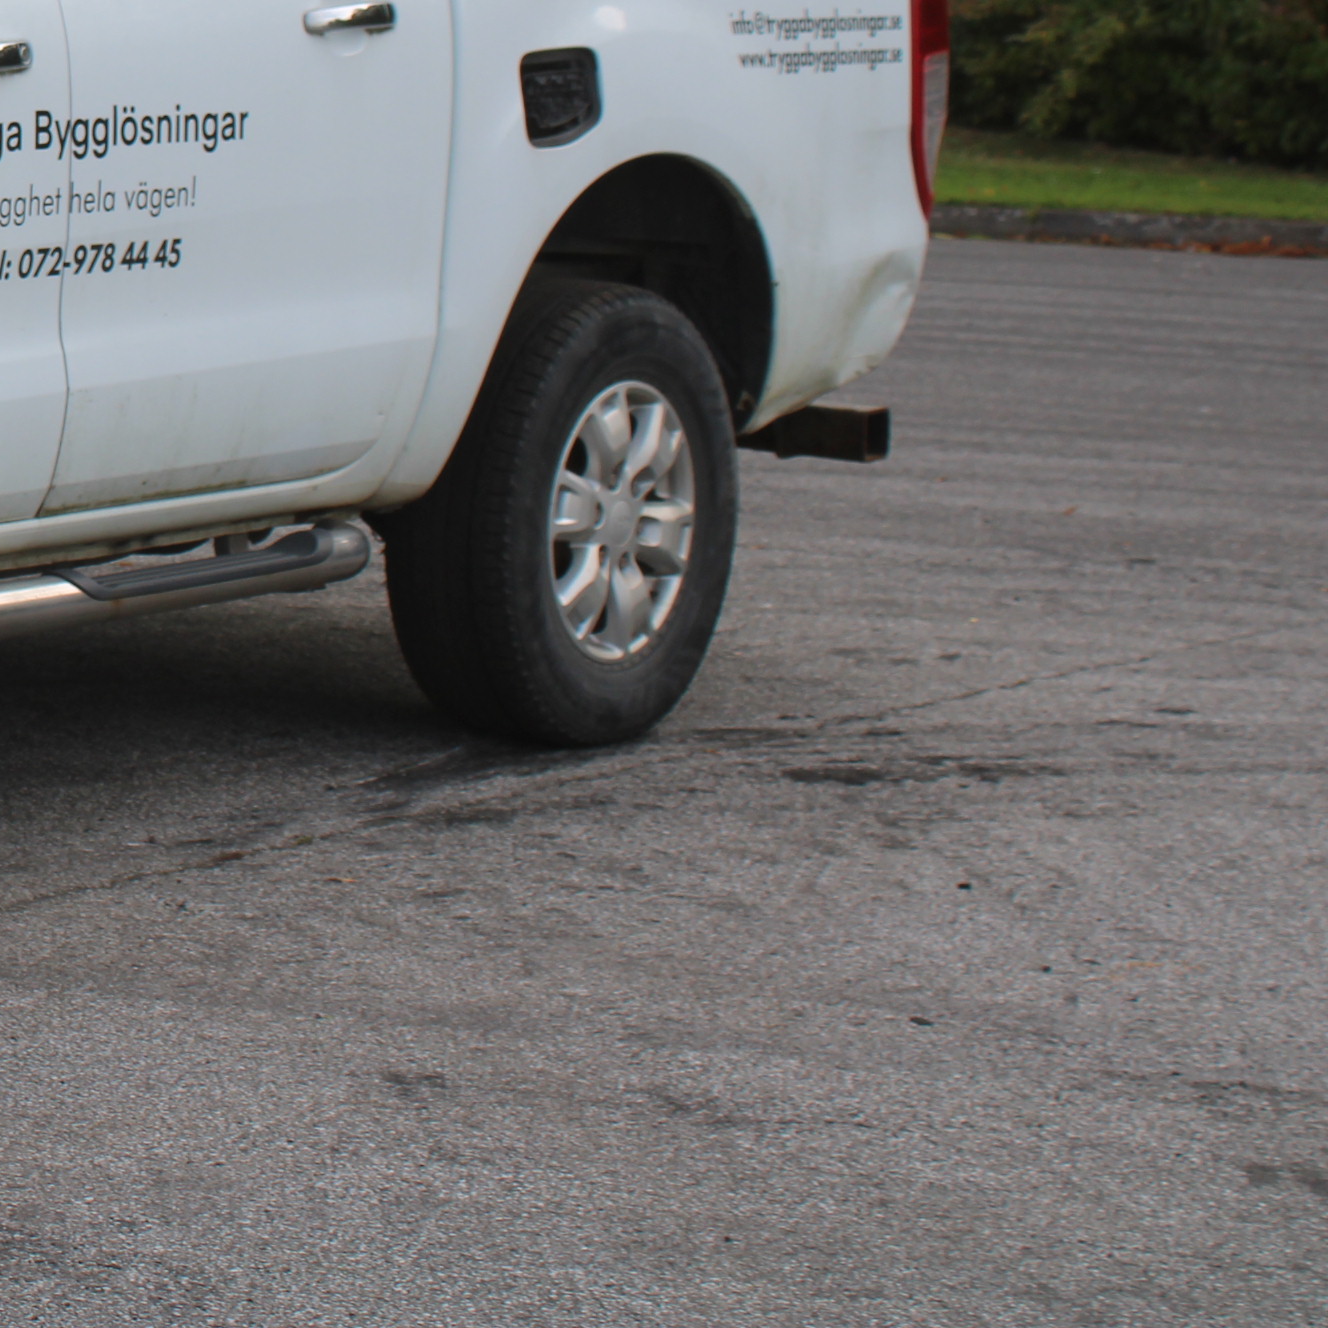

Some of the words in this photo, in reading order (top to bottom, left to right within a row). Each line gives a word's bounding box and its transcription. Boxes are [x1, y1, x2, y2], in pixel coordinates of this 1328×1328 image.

[34, 104, 249, 160] Bygglösningar
[68, 180, 116, 215] hela
[124, 175, 197, 217] vägen!
[17, 242, 115, 279] 072-978
[121, 241, 150, 271] 44
[153, 238, 183, 269] 45
